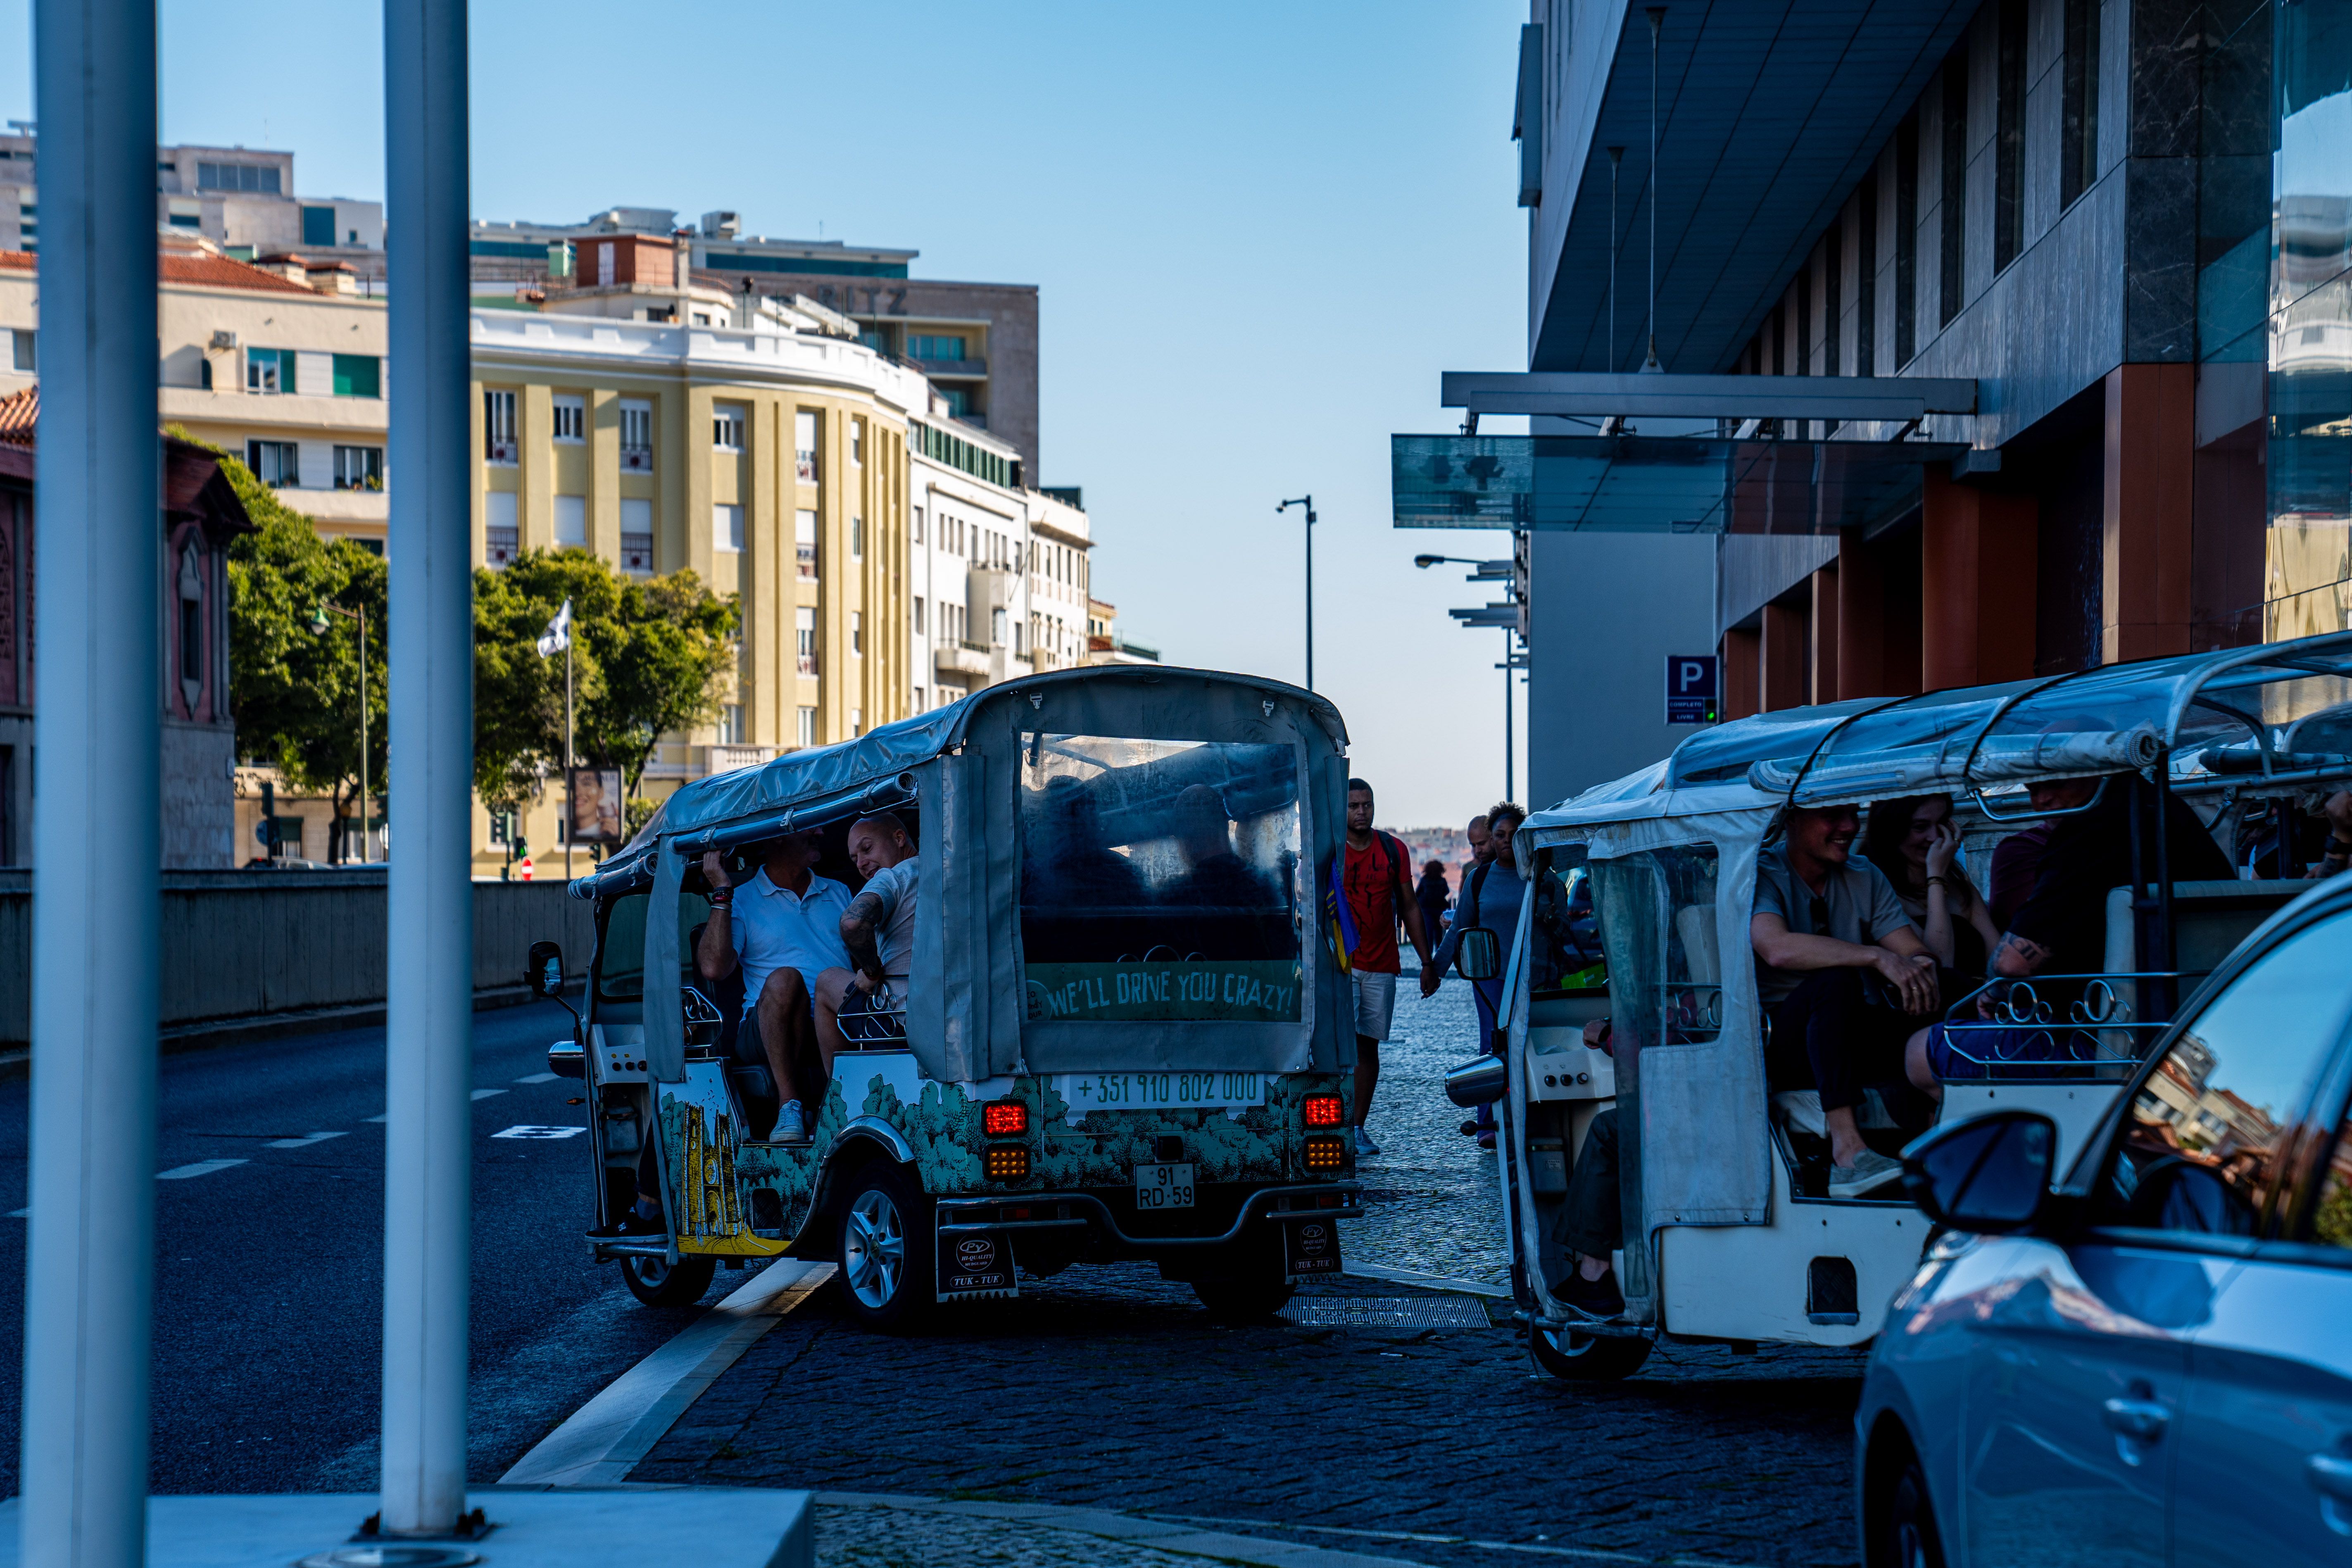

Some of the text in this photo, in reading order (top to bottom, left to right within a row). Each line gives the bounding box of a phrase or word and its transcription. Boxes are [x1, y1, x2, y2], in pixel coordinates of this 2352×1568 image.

[817, 284, 908, 316] RITZ
[1680, 662, 1703, 692] P
[1046, 971, 1294, 1016] WE'LL DRIVE YOU CRAZY!
[1137, 1074, 1169, 1102] 910
[1179, 1074, 1215, 1102] 802
[1223, 1072, 1256, 1100] 000
[1158, 1167, 1173, 1186] 91
